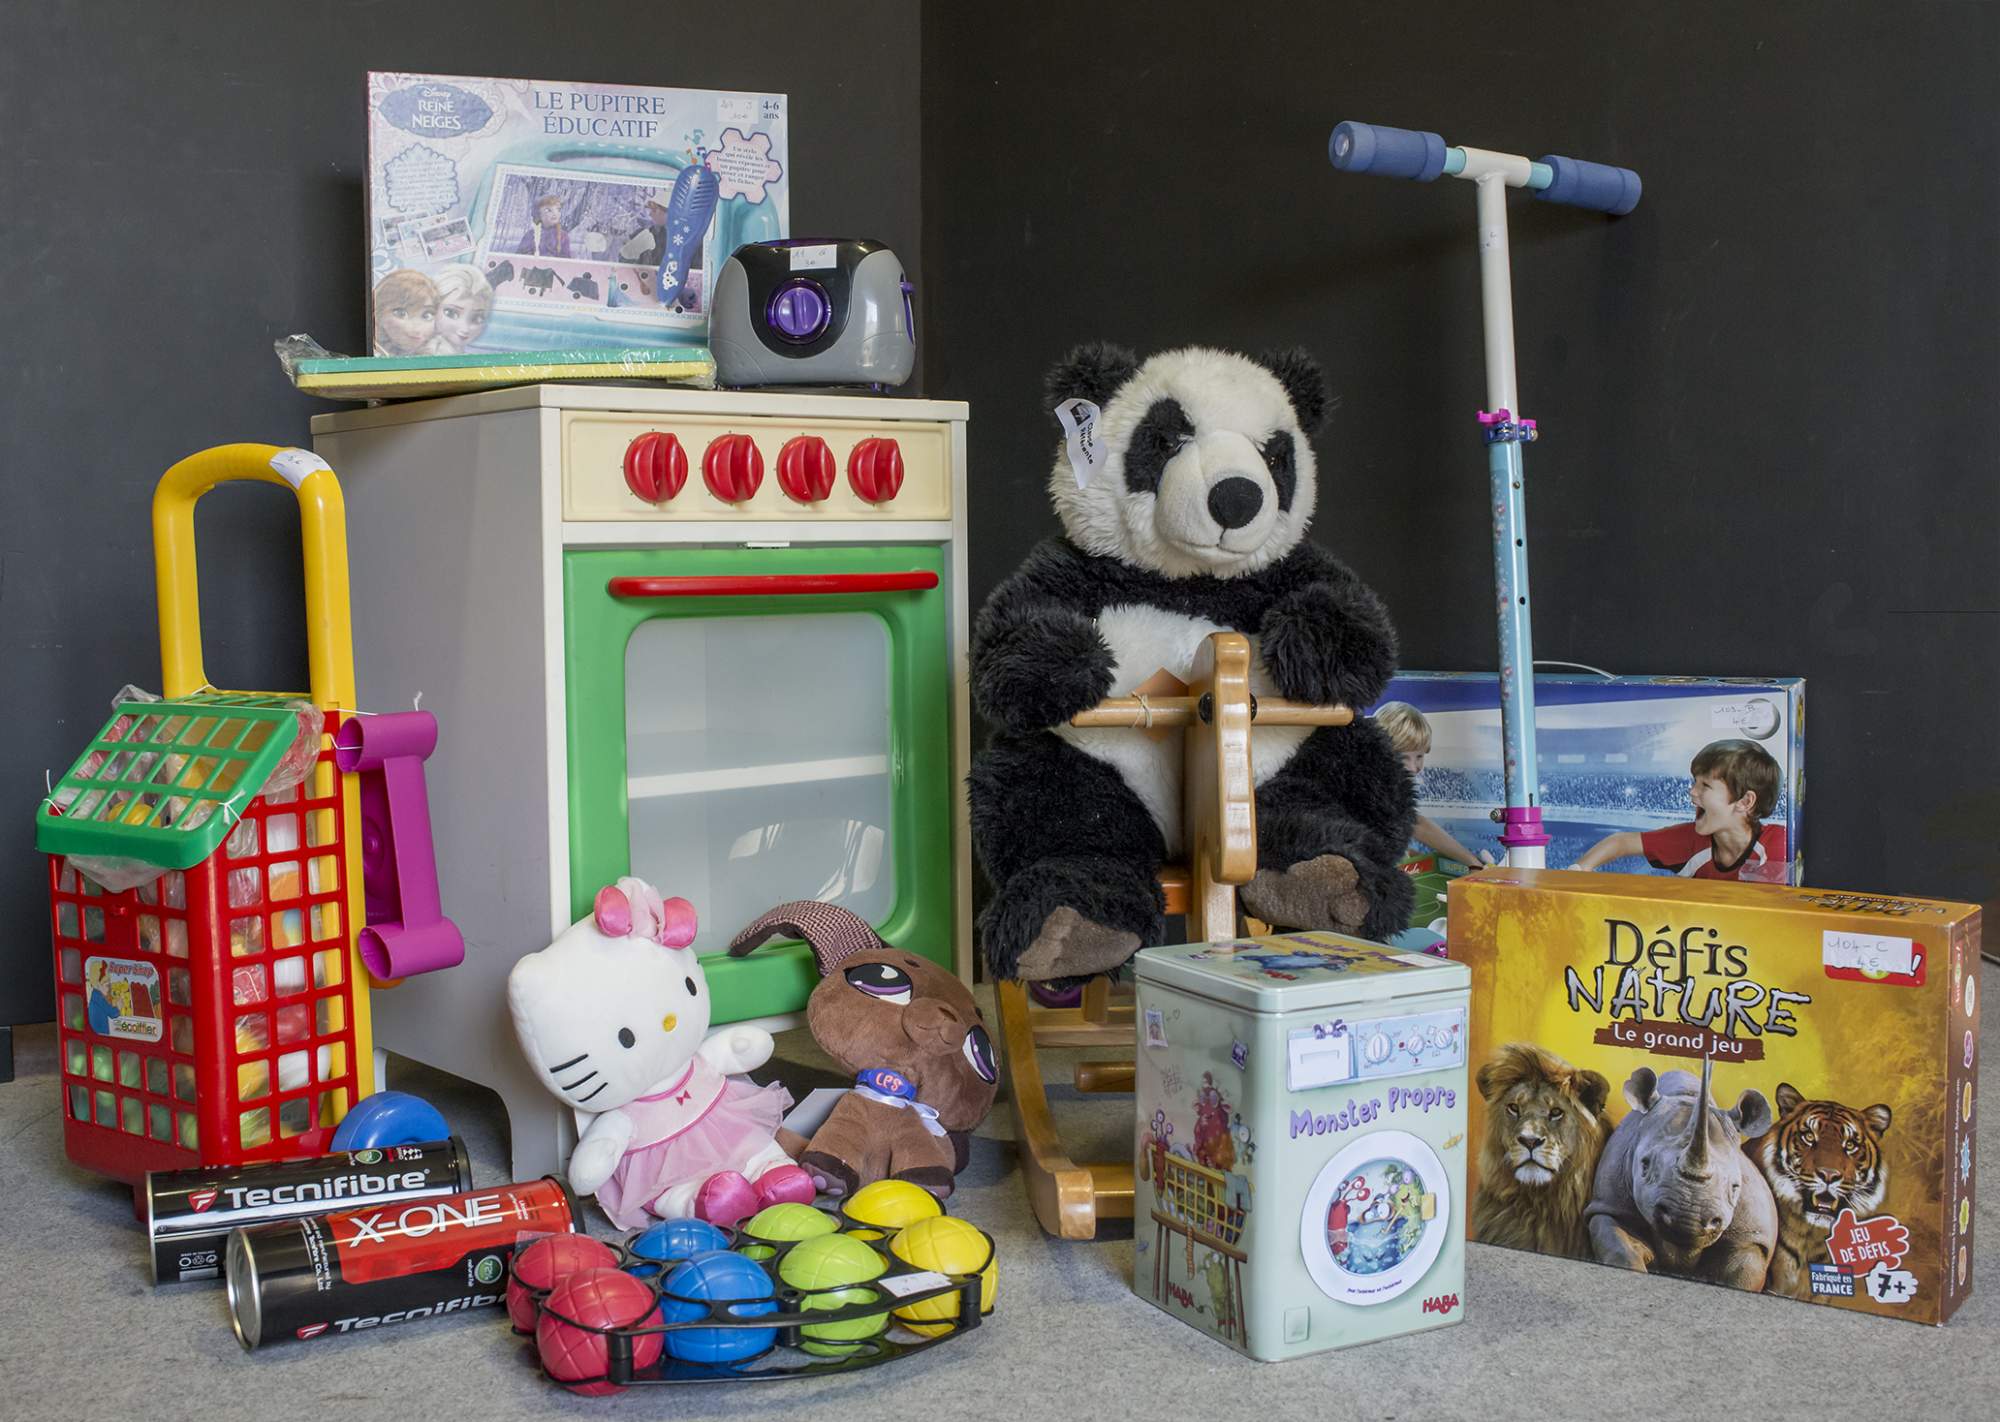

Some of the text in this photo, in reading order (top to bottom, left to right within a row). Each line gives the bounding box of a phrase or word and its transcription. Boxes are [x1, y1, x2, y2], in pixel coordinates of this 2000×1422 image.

[418, 99, 455, 112] REINE
[534, 91, 666, 115] LE PUPITRE
[762, 101, 780, 110] 4-6
[411, 114, 461, 130] NEIGES
[543, 111, 658, 138] ÉDUCATIF
[763, 112, 780, 120] ans
[1604, 918, 1748, 983] Défis
[1615, 1023, 1743, 1054] Le grand jeu
[876, 1072, 903, 1092] LPS
[1290, 1086, 1456, 1139] Monster Propre
[224, 1170, 427, 1209] Tecnifibre
[350, 1194, 502, 1247] X-ONE
[1850, 1227, 1870, 1244] JEU
[1840, 1241, 1890, 1263] DE DÉFIS
[1811, 1272, 1852, 1284] Fabriqué en
[1812, 1283, 1853, 1295] FRANCE
[1878, 1272, 1906, 1298] 7+
[334, 1293, 507, 1332] Tecnifibr
[1423, 1294, 1459, 1314] HABA
